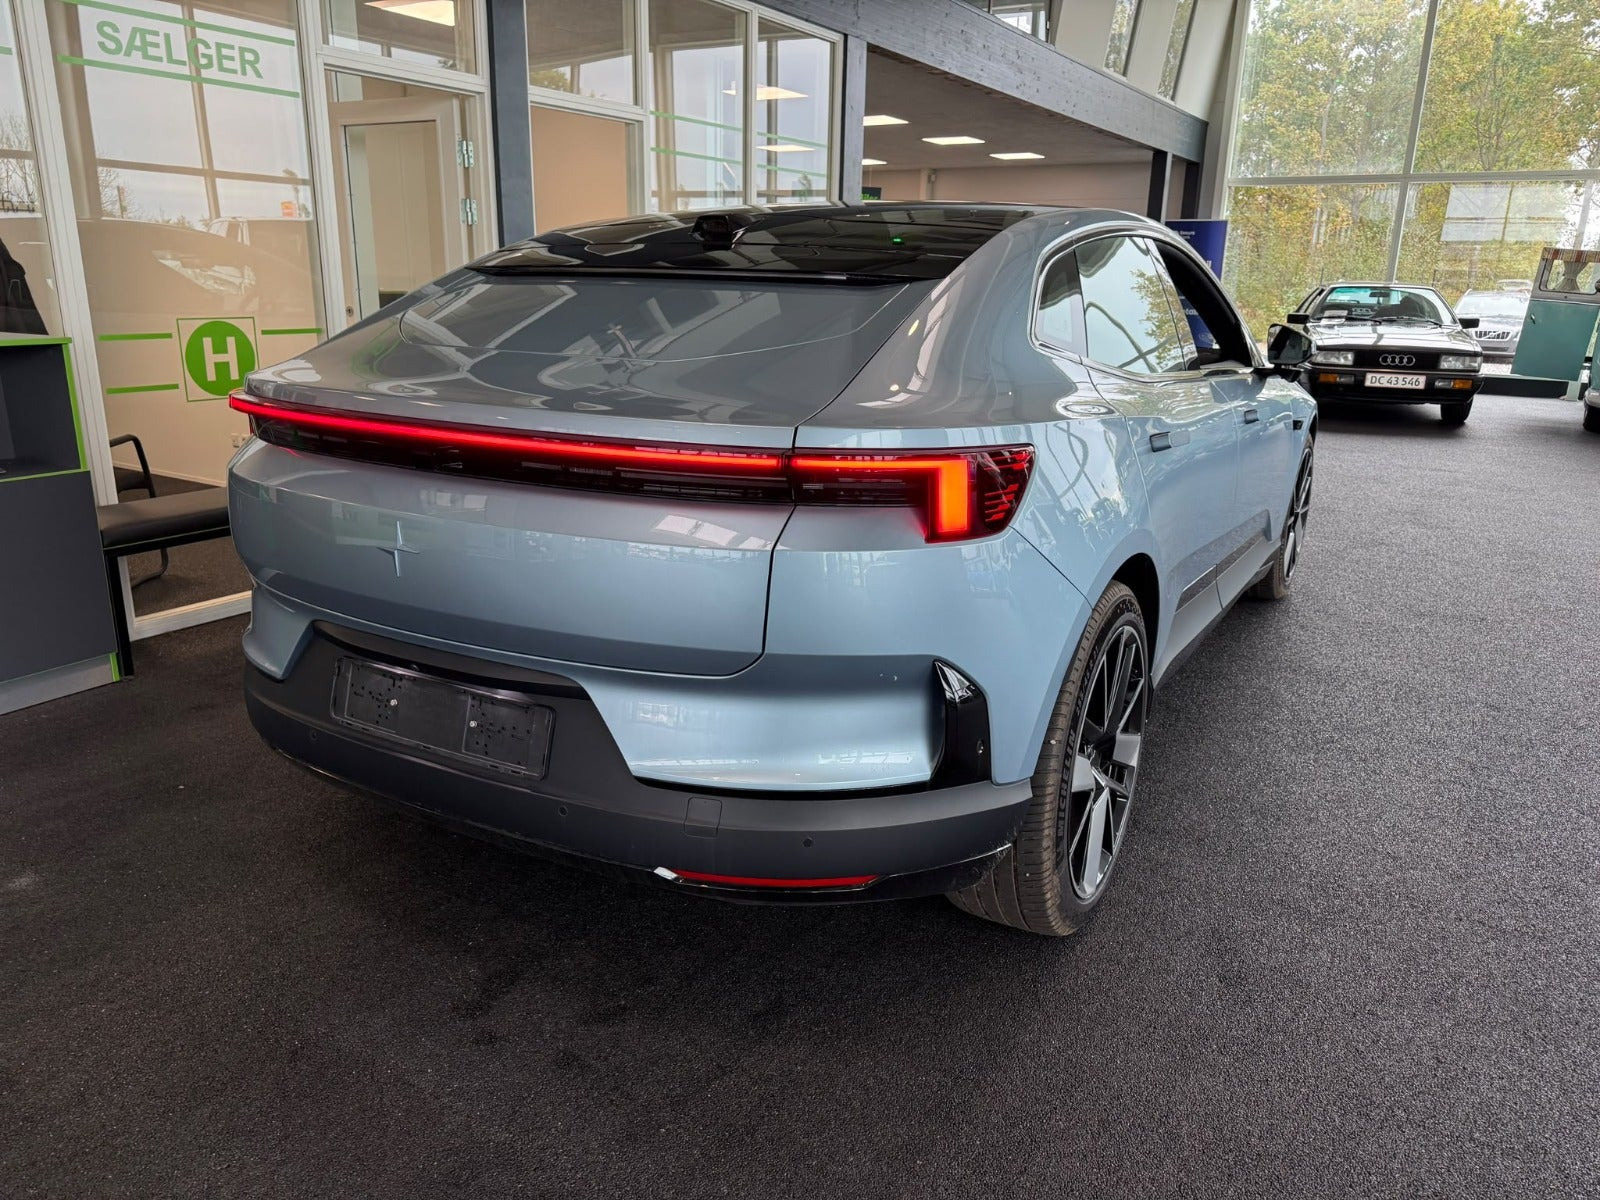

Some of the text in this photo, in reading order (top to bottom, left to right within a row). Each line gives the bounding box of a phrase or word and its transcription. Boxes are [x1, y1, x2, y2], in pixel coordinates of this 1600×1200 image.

[97, 21, 263, 79] SÆLGER
[202, 336, 239, 382] H
[1370, 375, 1421, 387] DC 43 546
[1057, 728, 1076, 837] MICHELIN
